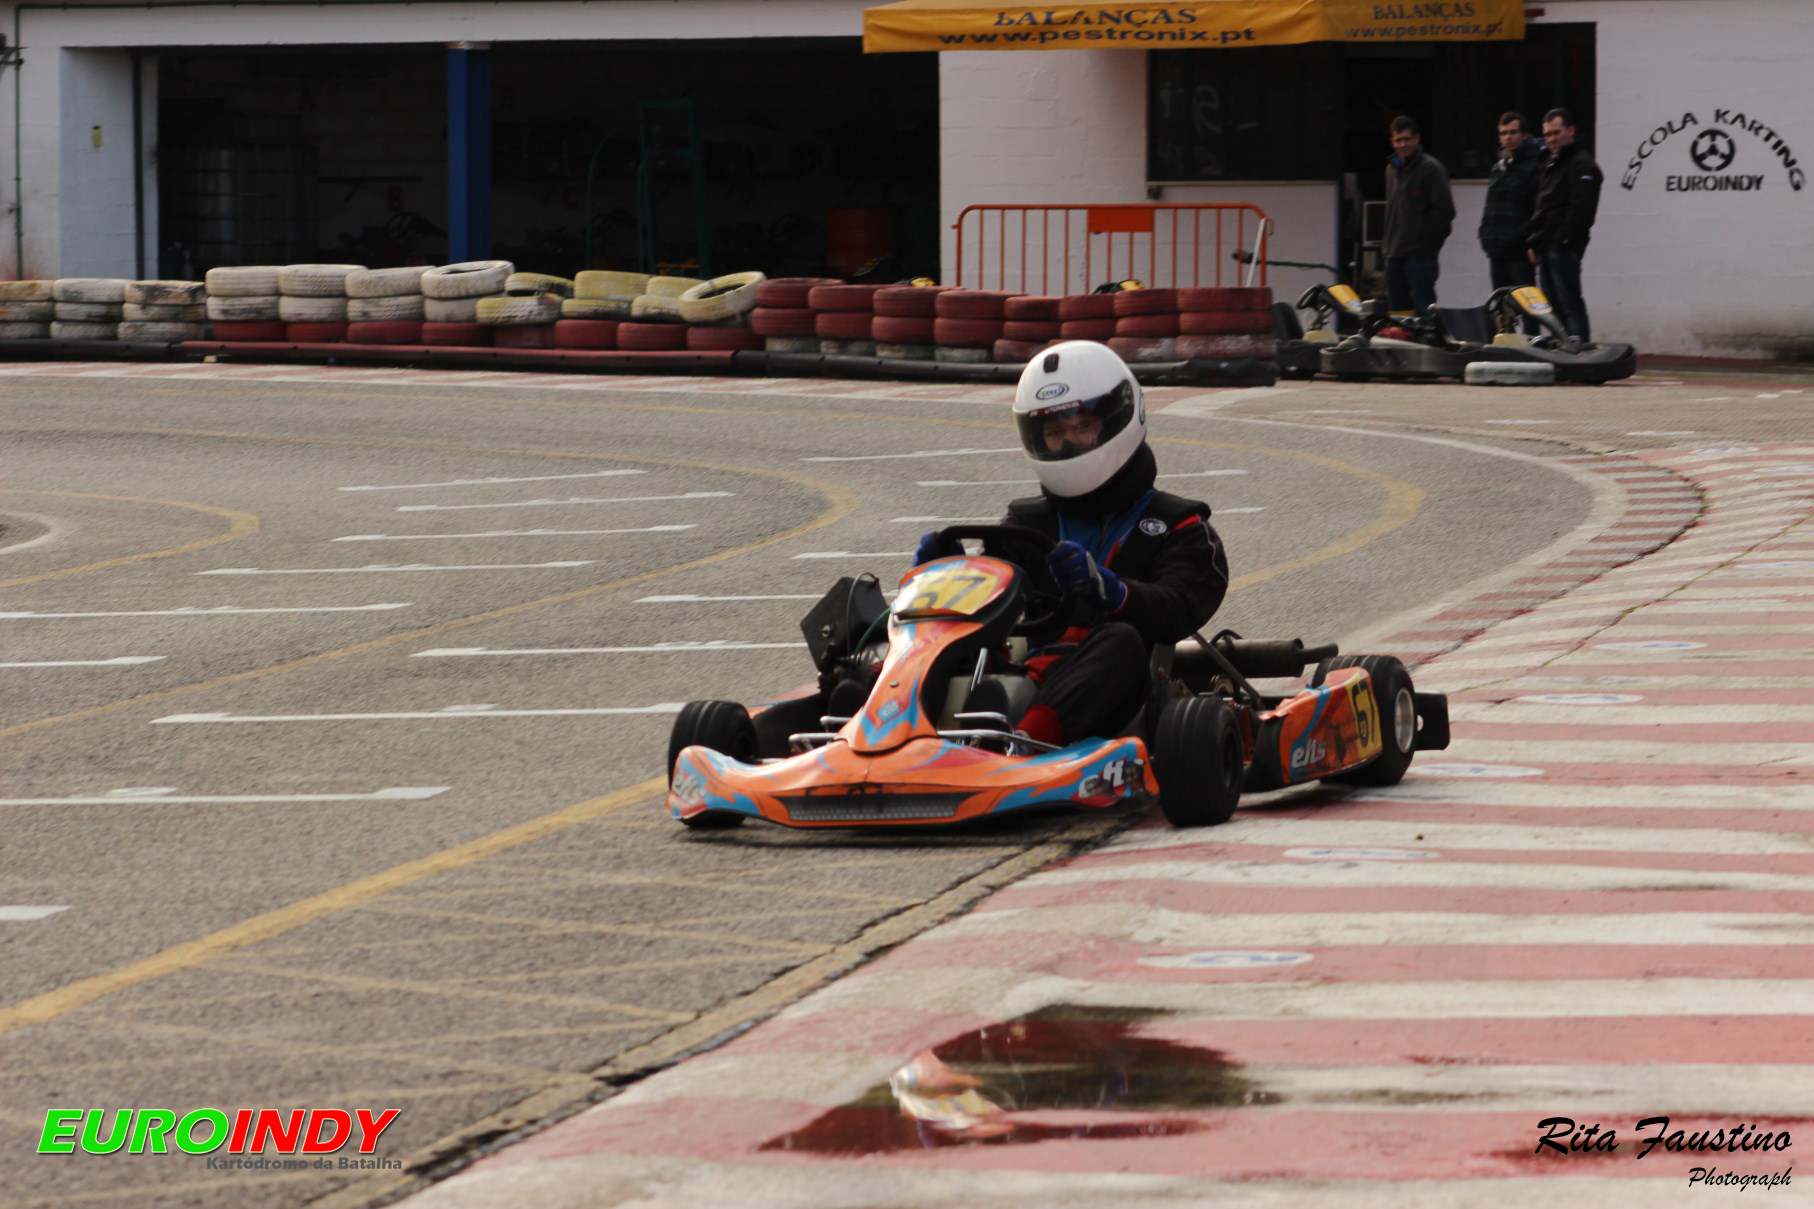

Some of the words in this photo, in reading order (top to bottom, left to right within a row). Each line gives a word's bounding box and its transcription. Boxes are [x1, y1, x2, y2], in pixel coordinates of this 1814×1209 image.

[938, 28, 1257, 44] www.pestronix.pt
[1620, 112, 1698, 191] ESCOLA
[1714, 108, 1806, 191] KARTING
[1665, 174, 1764, 192] EUROINDY
